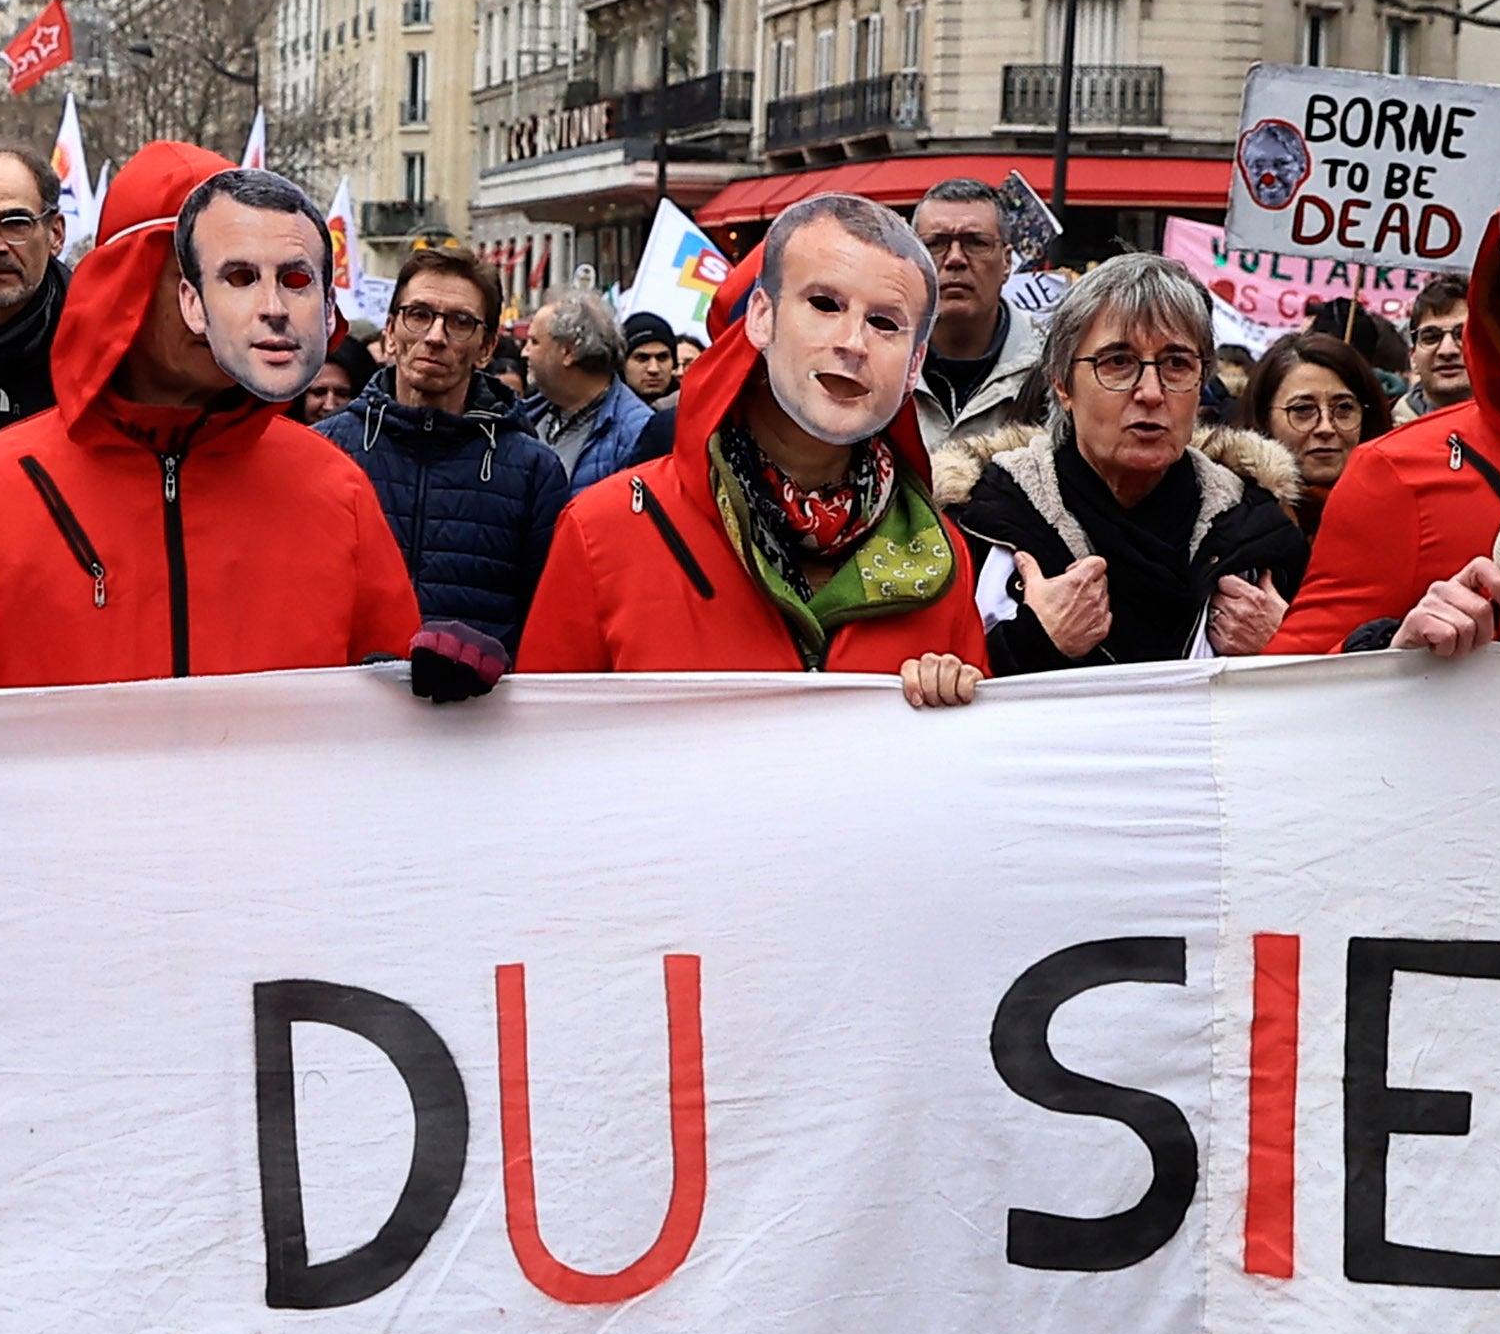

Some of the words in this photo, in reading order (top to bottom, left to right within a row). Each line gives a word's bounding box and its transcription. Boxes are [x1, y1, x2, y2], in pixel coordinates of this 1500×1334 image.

[1305, 94, 1477, 159] BORNE
[1321, 158, 1369, 193] TO
[1384, 162, 1438, 199] BE
[1291, 195, 1463, 259] DEAD
[253, 953, 708, 1309] DU
